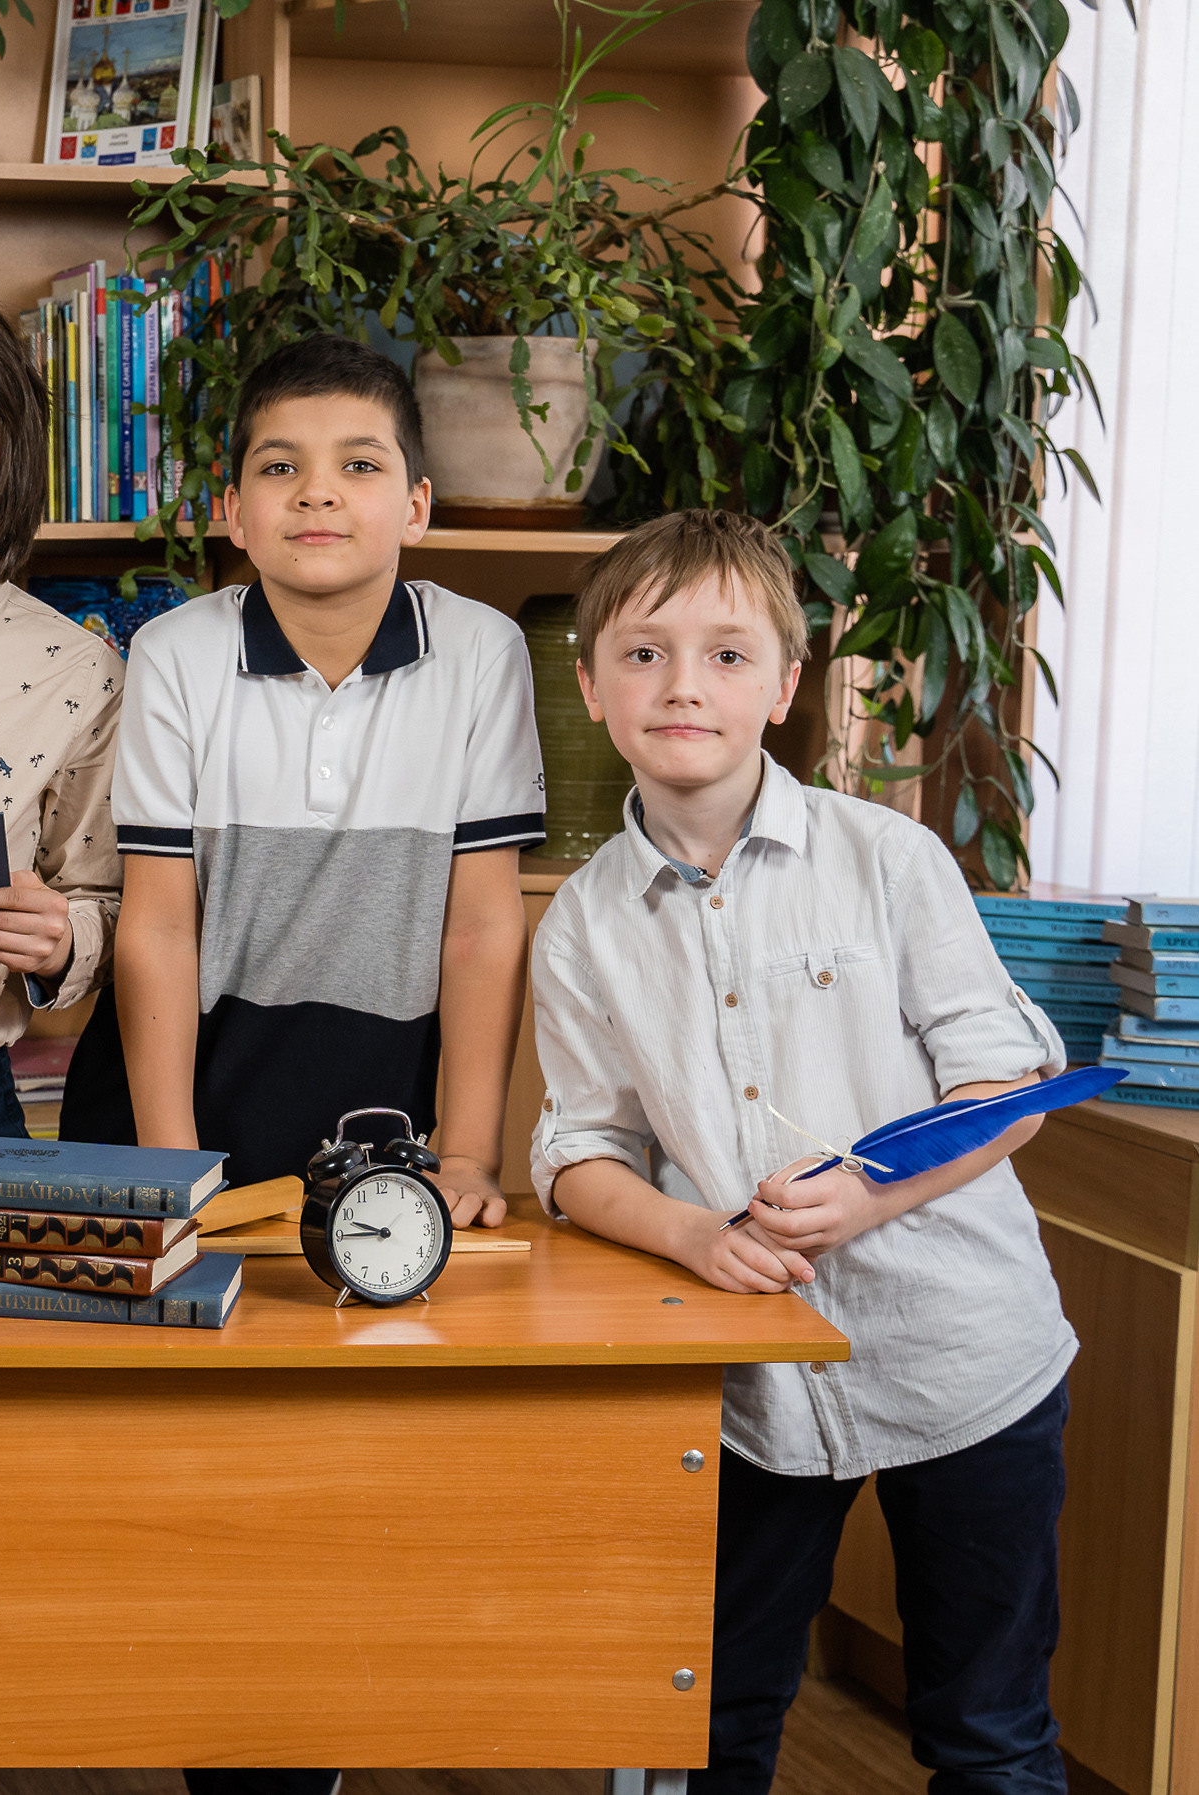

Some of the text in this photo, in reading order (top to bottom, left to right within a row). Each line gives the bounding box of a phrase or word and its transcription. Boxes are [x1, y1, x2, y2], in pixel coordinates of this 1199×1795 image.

[148, 313, 156, 374] МАТЕМАТИКА
[376, 1182, 388, 1194] 12
[400, 1187, 405, 1199] 1
[356, 1190, 367, 1203] 11
[415, 1201, 423, 1214] 2
[342, 1208, 354, 1221] 10
[335, 1229, 343, 1242] 9
[423, 1224, 430, 1236] 3
[343, 1251, 352, 1264] 8
[416, 1246, 425, 1258] 4
[7, 1257, 22, 1266] 3
[360, 1265, 369, 1279] 7
[403, 1264, 411, 1277] 5
[381, 1271, 390, 1284] 6
